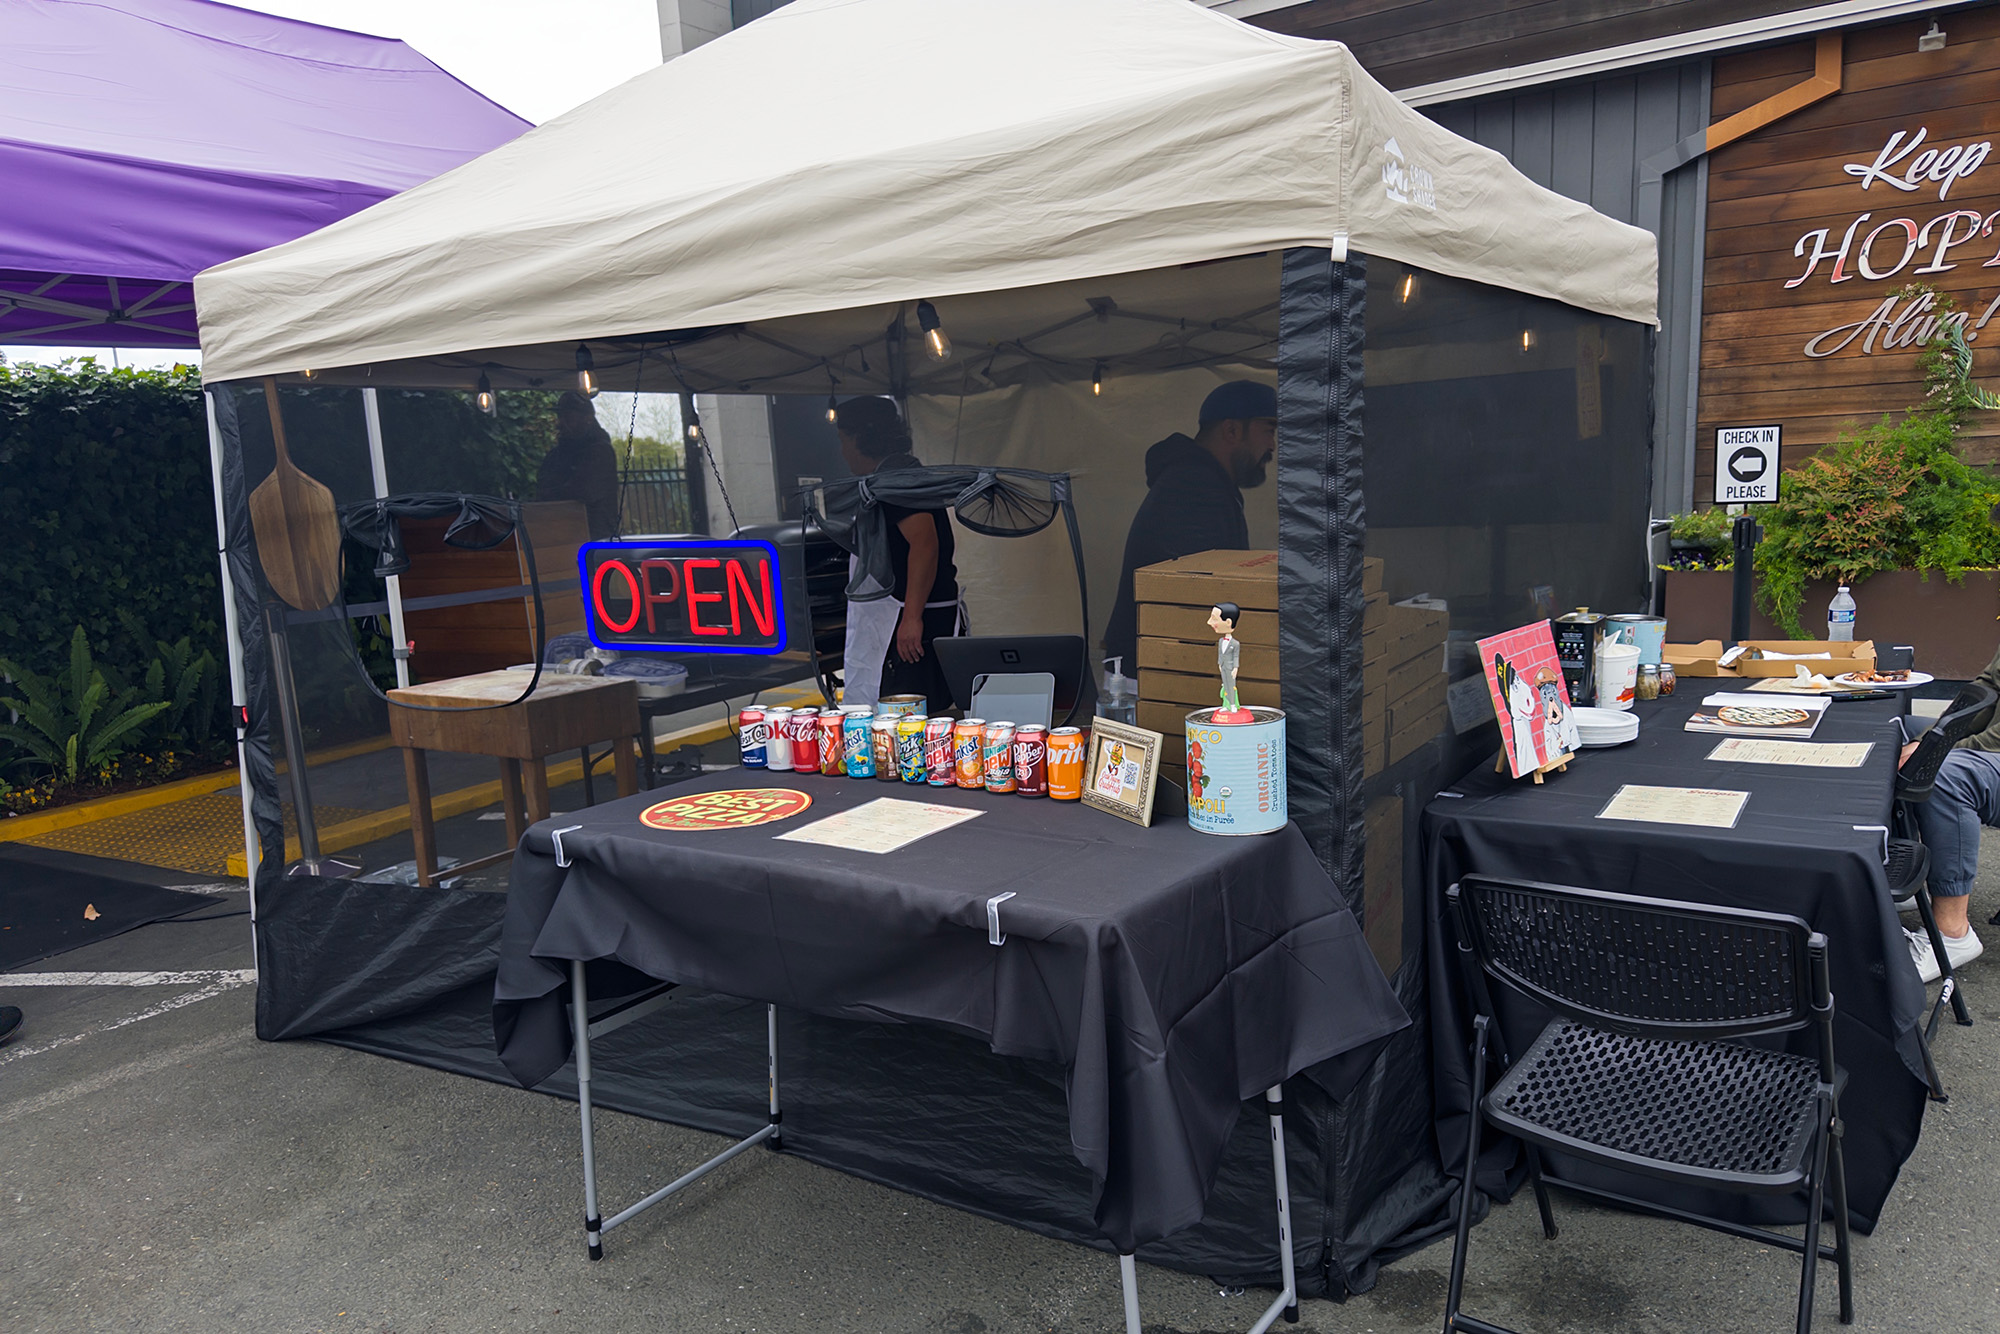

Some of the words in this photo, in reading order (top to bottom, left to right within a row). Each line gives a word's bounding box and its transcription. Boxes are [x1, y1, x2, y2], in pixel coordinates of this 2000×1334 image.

[1843, 127, 1992, 201] Keep
[1724, 430, 1759, 444] CHECK
[1762, 430, 1774, 442] IN
[1726, 485, 1766, 498] PLEASE
[592, 558, 775, 637] OPEN
[1014, 745, 1043, 765] Pepper
[1257, 742, 1270, 813] ORGANIC
[694, 794, 798, 812] BEST
[654, 803, 767, 824] PIZZA
